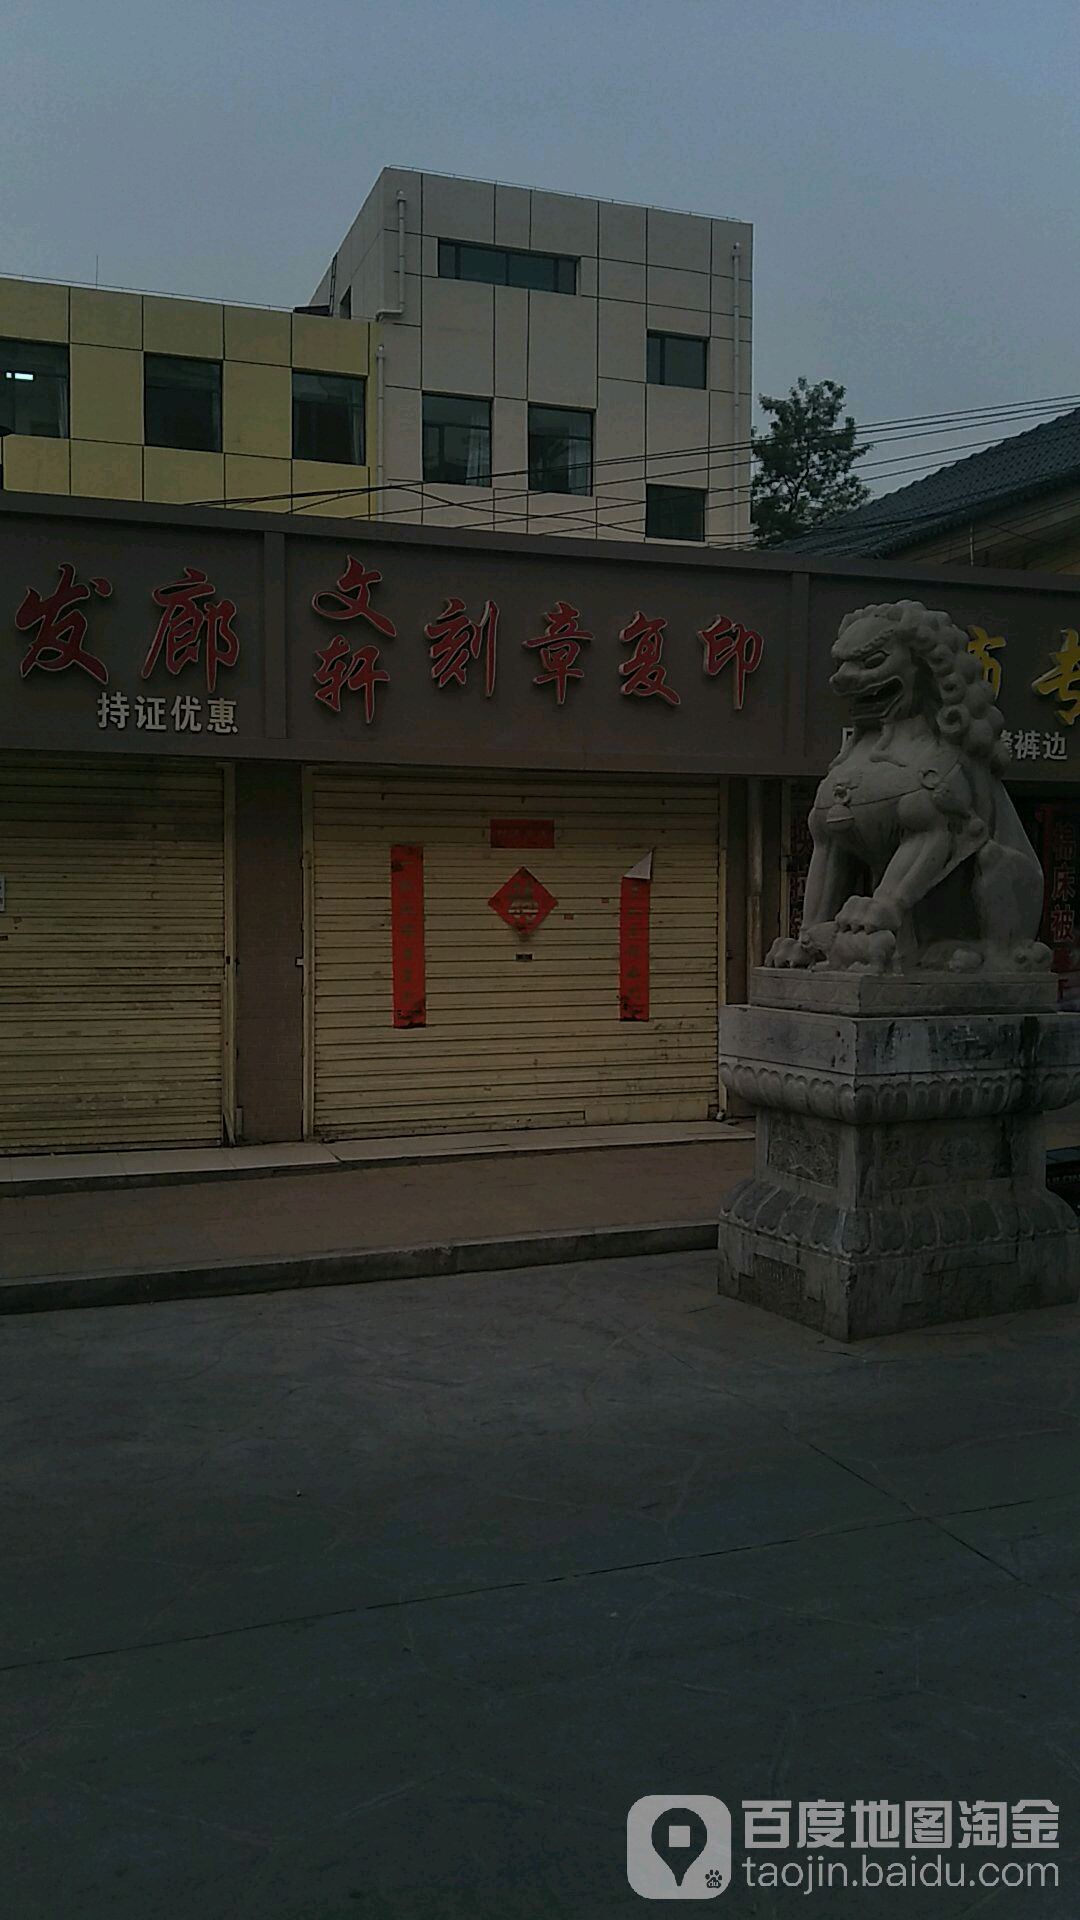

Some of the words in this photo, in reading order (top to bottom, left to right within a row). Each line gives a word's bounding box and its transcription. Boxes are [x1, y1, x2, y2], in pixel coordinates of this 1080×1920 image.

[15, 561, 241, 693] 发廊
[311, 554, 398, 725] 文轩
[424, 596, 765, 711] 刻章复印
[97, 690, 239, 734] 持证优惠
